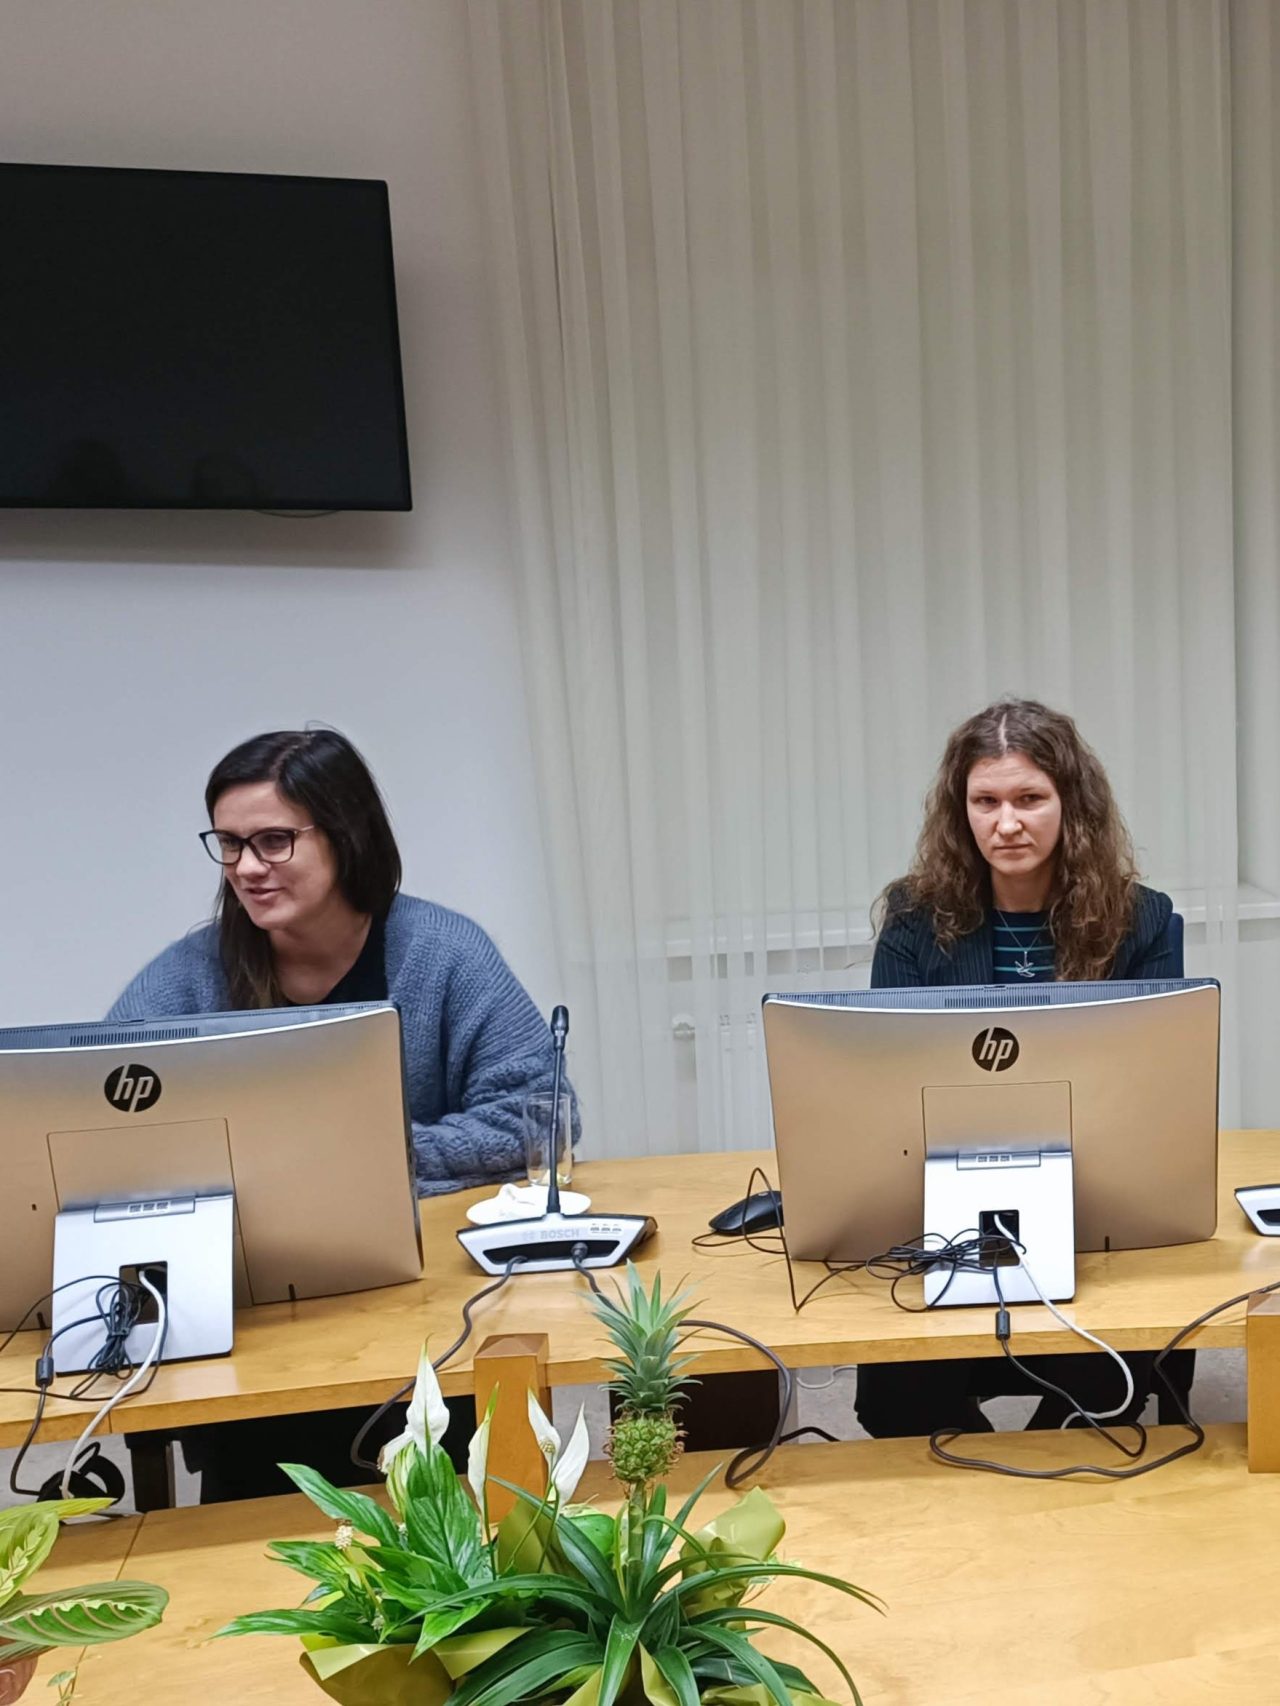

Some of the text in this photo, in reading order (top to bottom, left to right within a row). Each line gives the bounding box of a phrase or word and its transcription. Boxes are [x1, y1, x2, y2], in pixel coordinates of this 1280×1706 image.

[978, 1026, 1014, 1072] hp
[112, 1064, 155, 1113] hp
[539, 1227, 580, 1240] BOSCH
